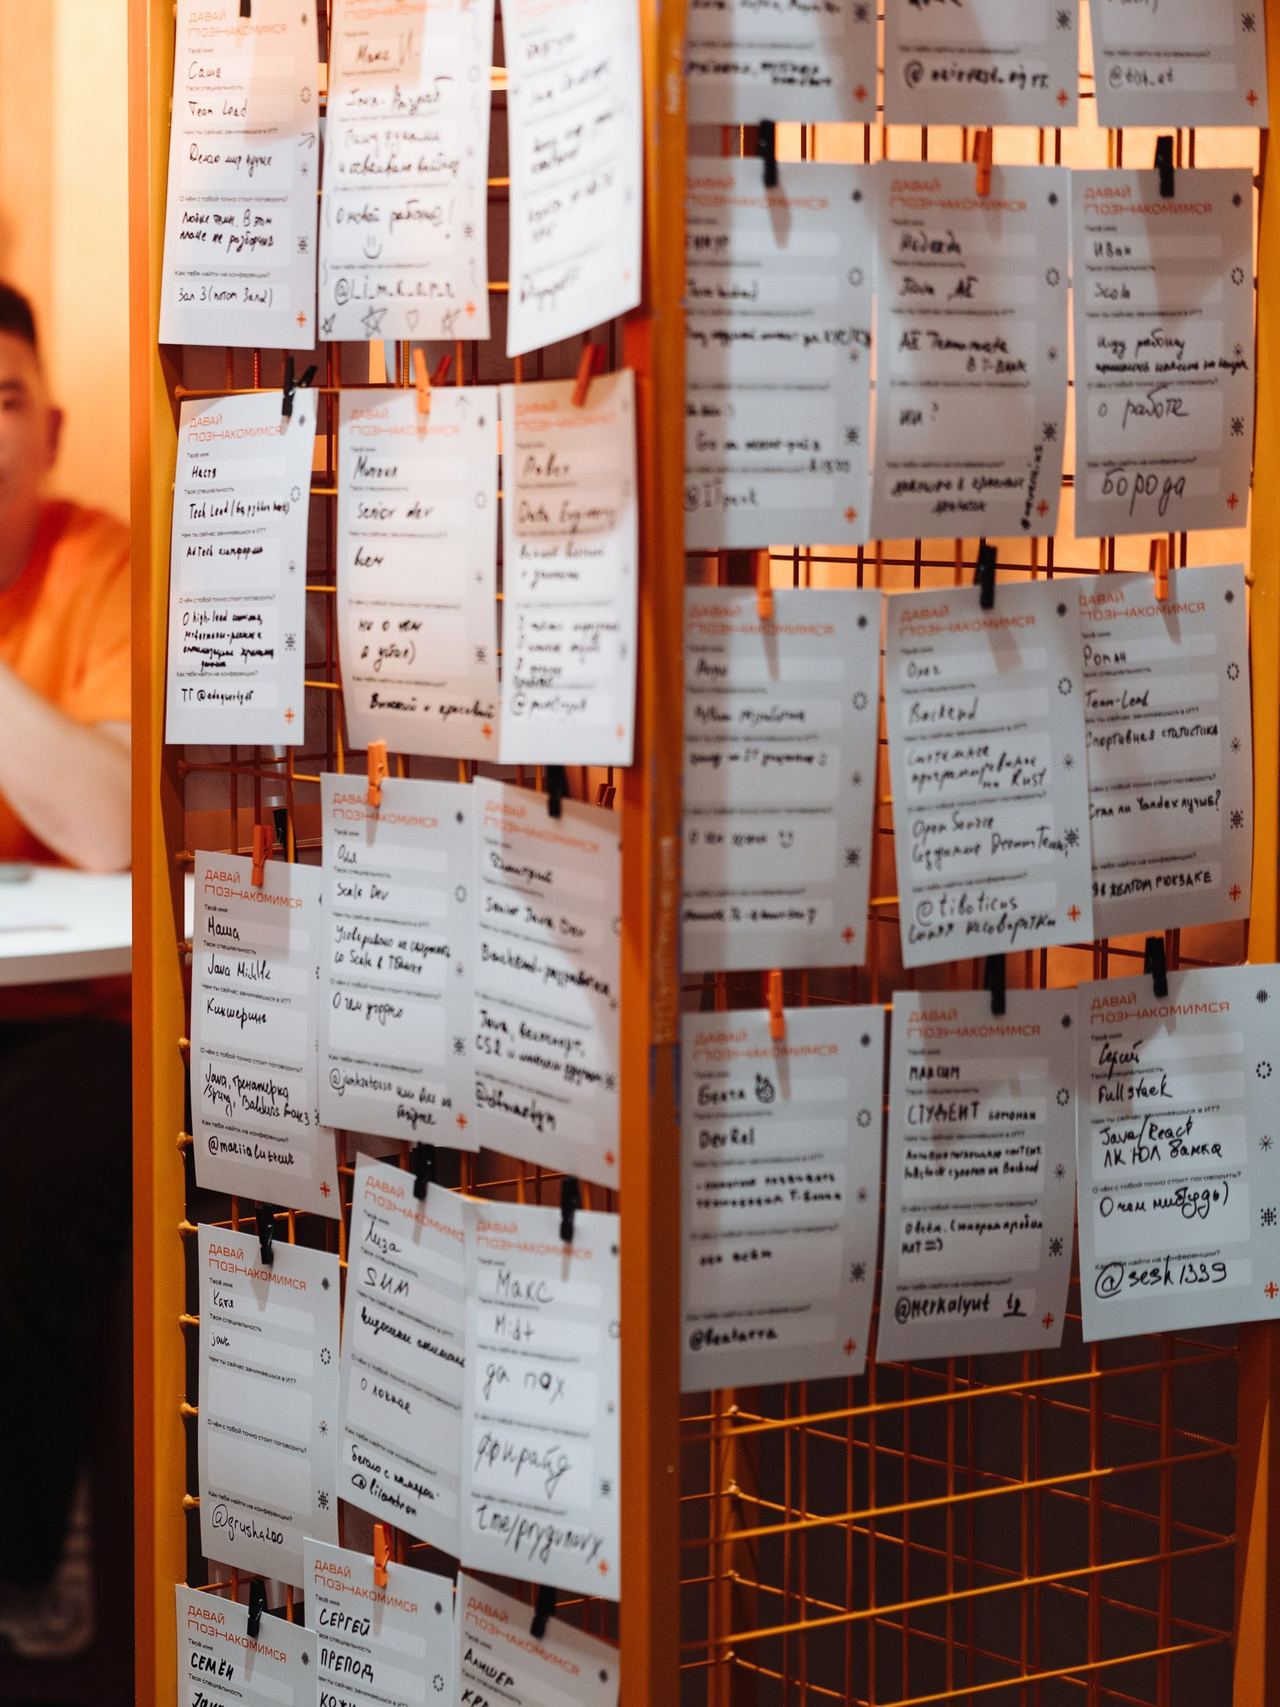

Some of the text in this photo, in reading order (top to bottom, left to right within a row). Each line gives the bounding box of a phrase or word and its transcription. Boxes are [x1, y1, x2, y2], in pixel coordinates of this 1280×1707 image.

[189, 413, 222, 429] ДАВАЙ
[188, 426, 282, 442] ПОЗНАКОМИМСЯ
[204, 869, 240, 883] ДАВАЙ
[204, 885, 302, 909] ПОЗНАКОМИМСЯ
[208, 954, 231, 977] Java
[1091, 992, 1137, 1011] ДАВАЙ
[1090, 1002, 1230, 1025] ПОЗНАКОМИМСЯ
[907, 1101, 980, 1126] СТУДЕНТ
[209, 1244, 244, 1260] ДАВАЙ
[209, 1258, 306, 1291] ПОЗНАКОМИМСЯ
[314, 1559, 351, 1579] ДАВАЙ
[314, 1574, 418, 1615] ПОЗНАКОМИМСЯ
[187, 1605, 225, 1625] ДАВАЙ
[319, 1608, 370, 1637] СЕРГЕЙ
[187, 1619, 287, 1664] ПОЗНАКОМИМСЯ
[320, 1648, 374, 1684] ПРЕПОД
